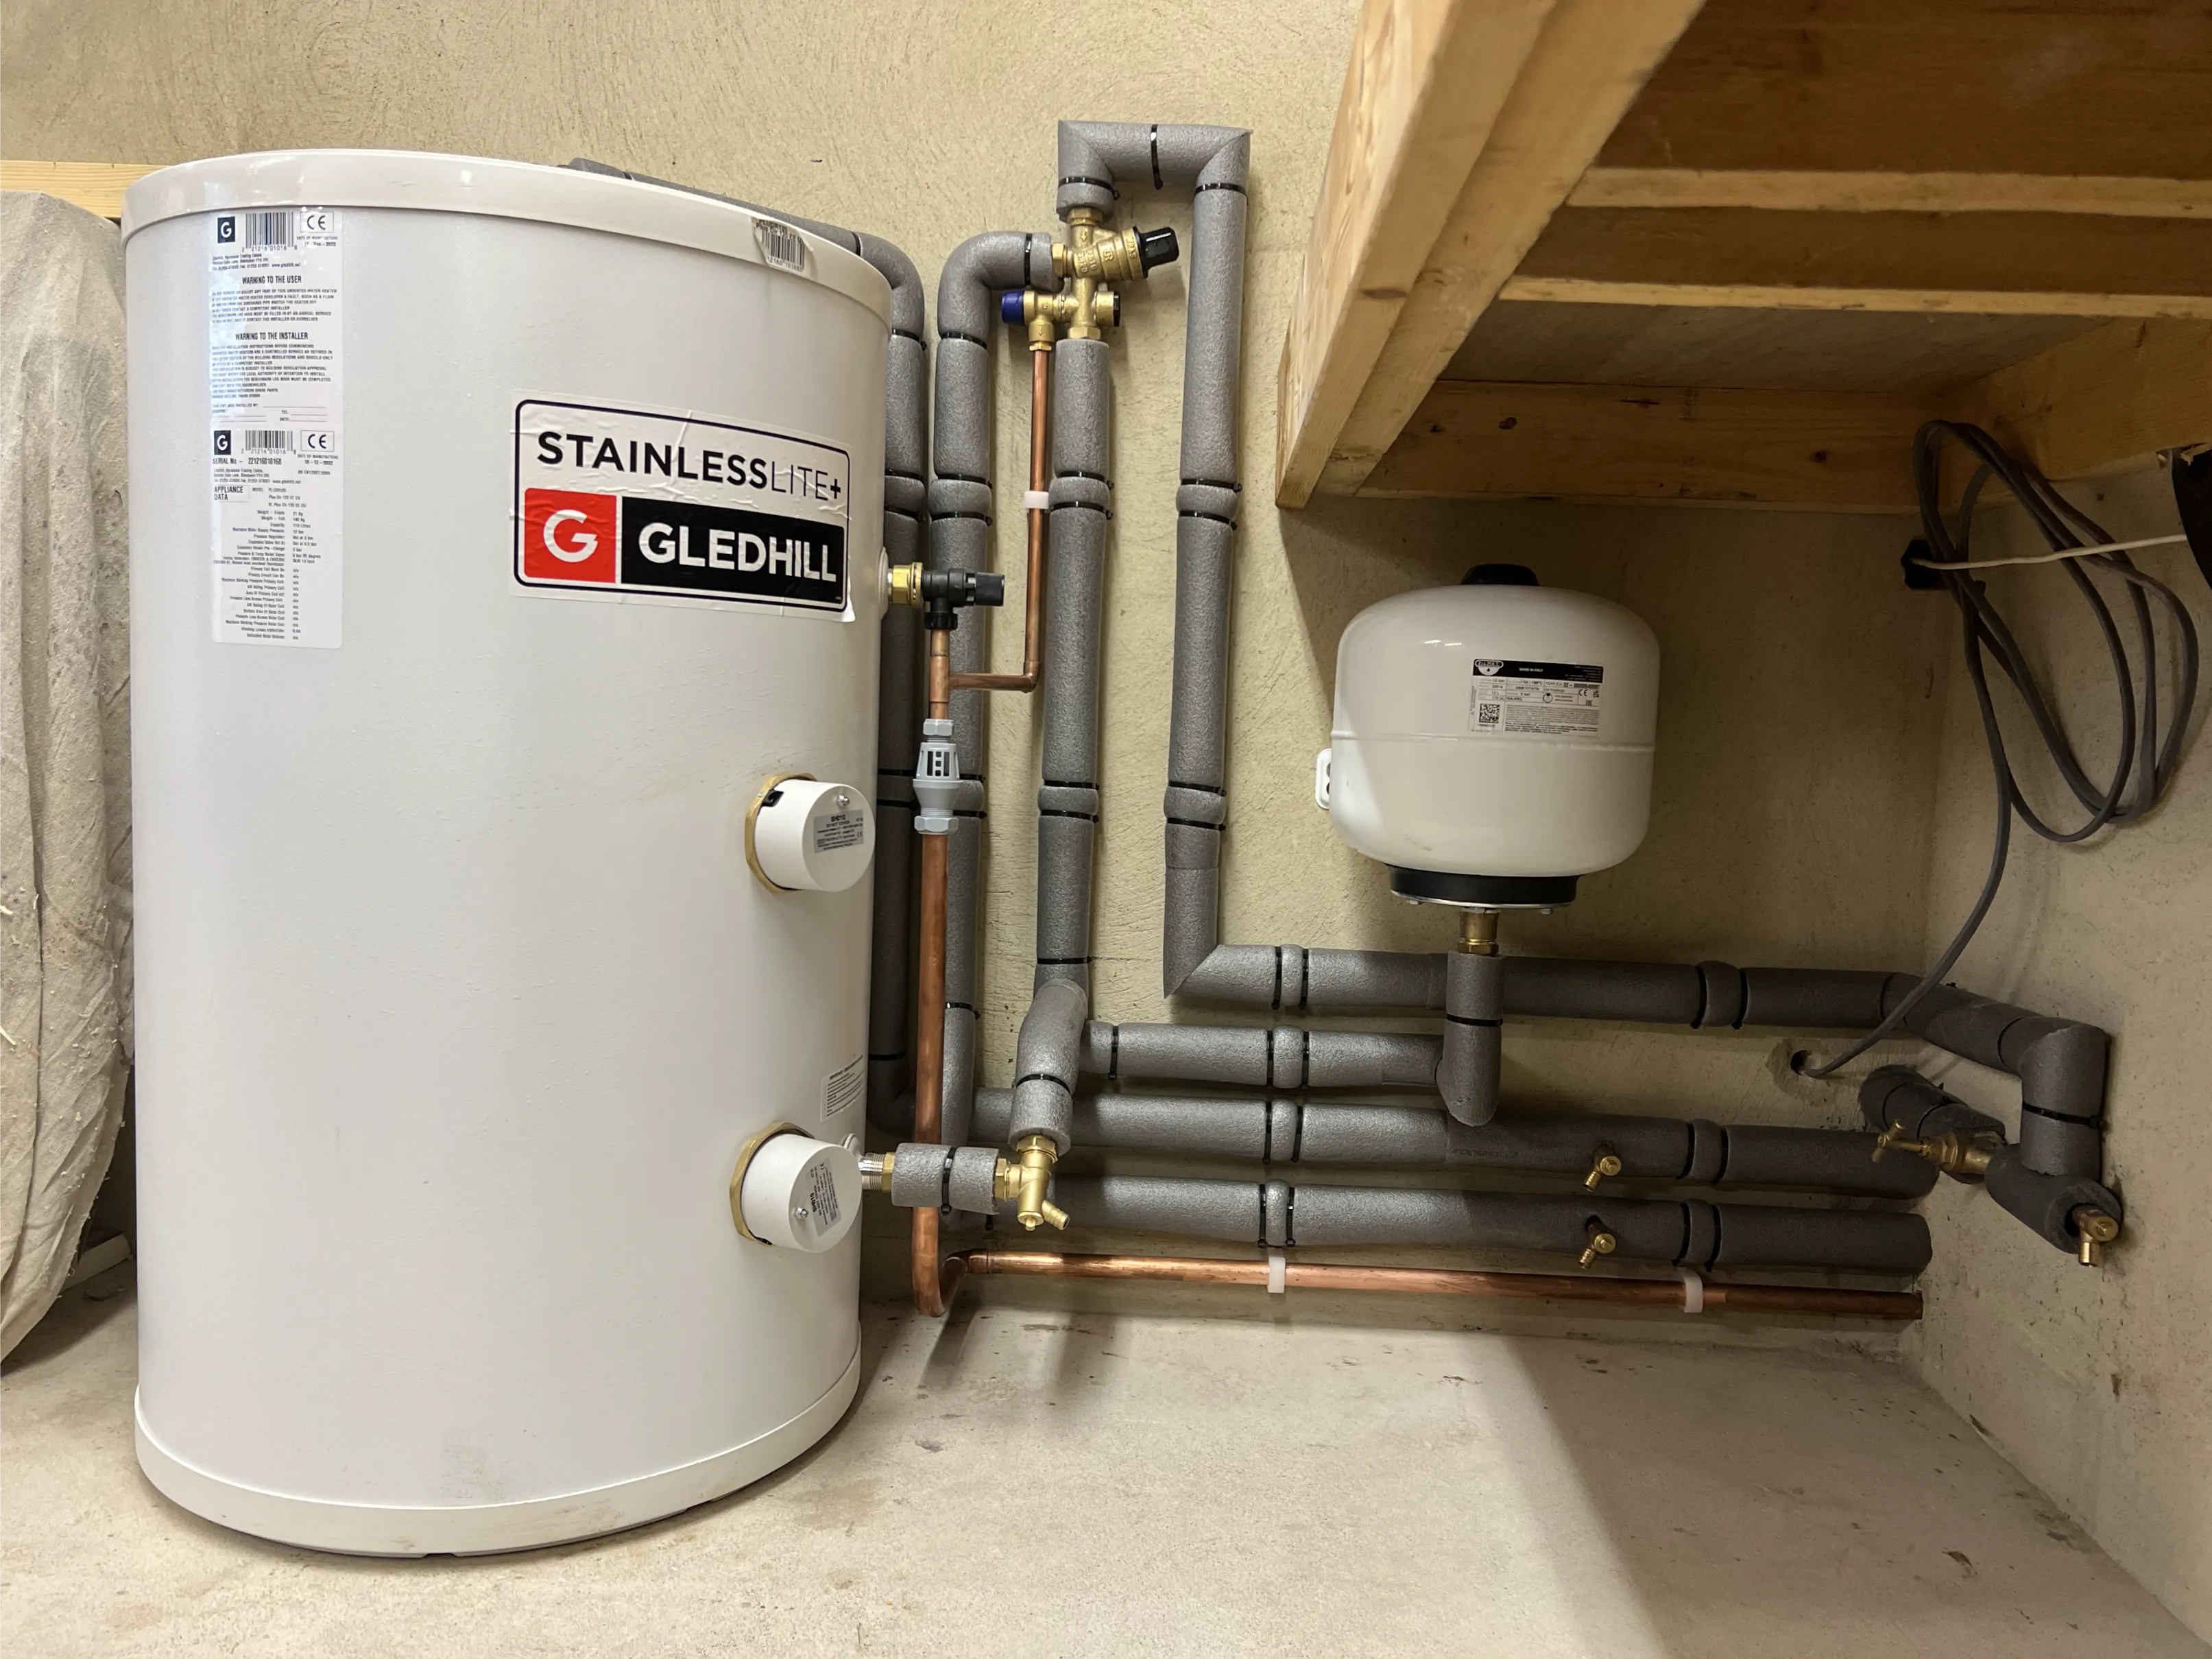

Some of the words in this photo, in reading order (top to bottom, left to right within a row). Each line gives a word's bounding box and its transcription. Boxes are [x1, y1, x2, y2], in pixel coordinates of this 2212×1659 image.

[221, 222, 232, 237] G
[307, 215, 326, 230] CE
[217, 435, 228, 451] G
[308, 434, 326, 449] CE
[543, 509, 599, 562] G
[638, 522, 837, 582] GLEDHILL
